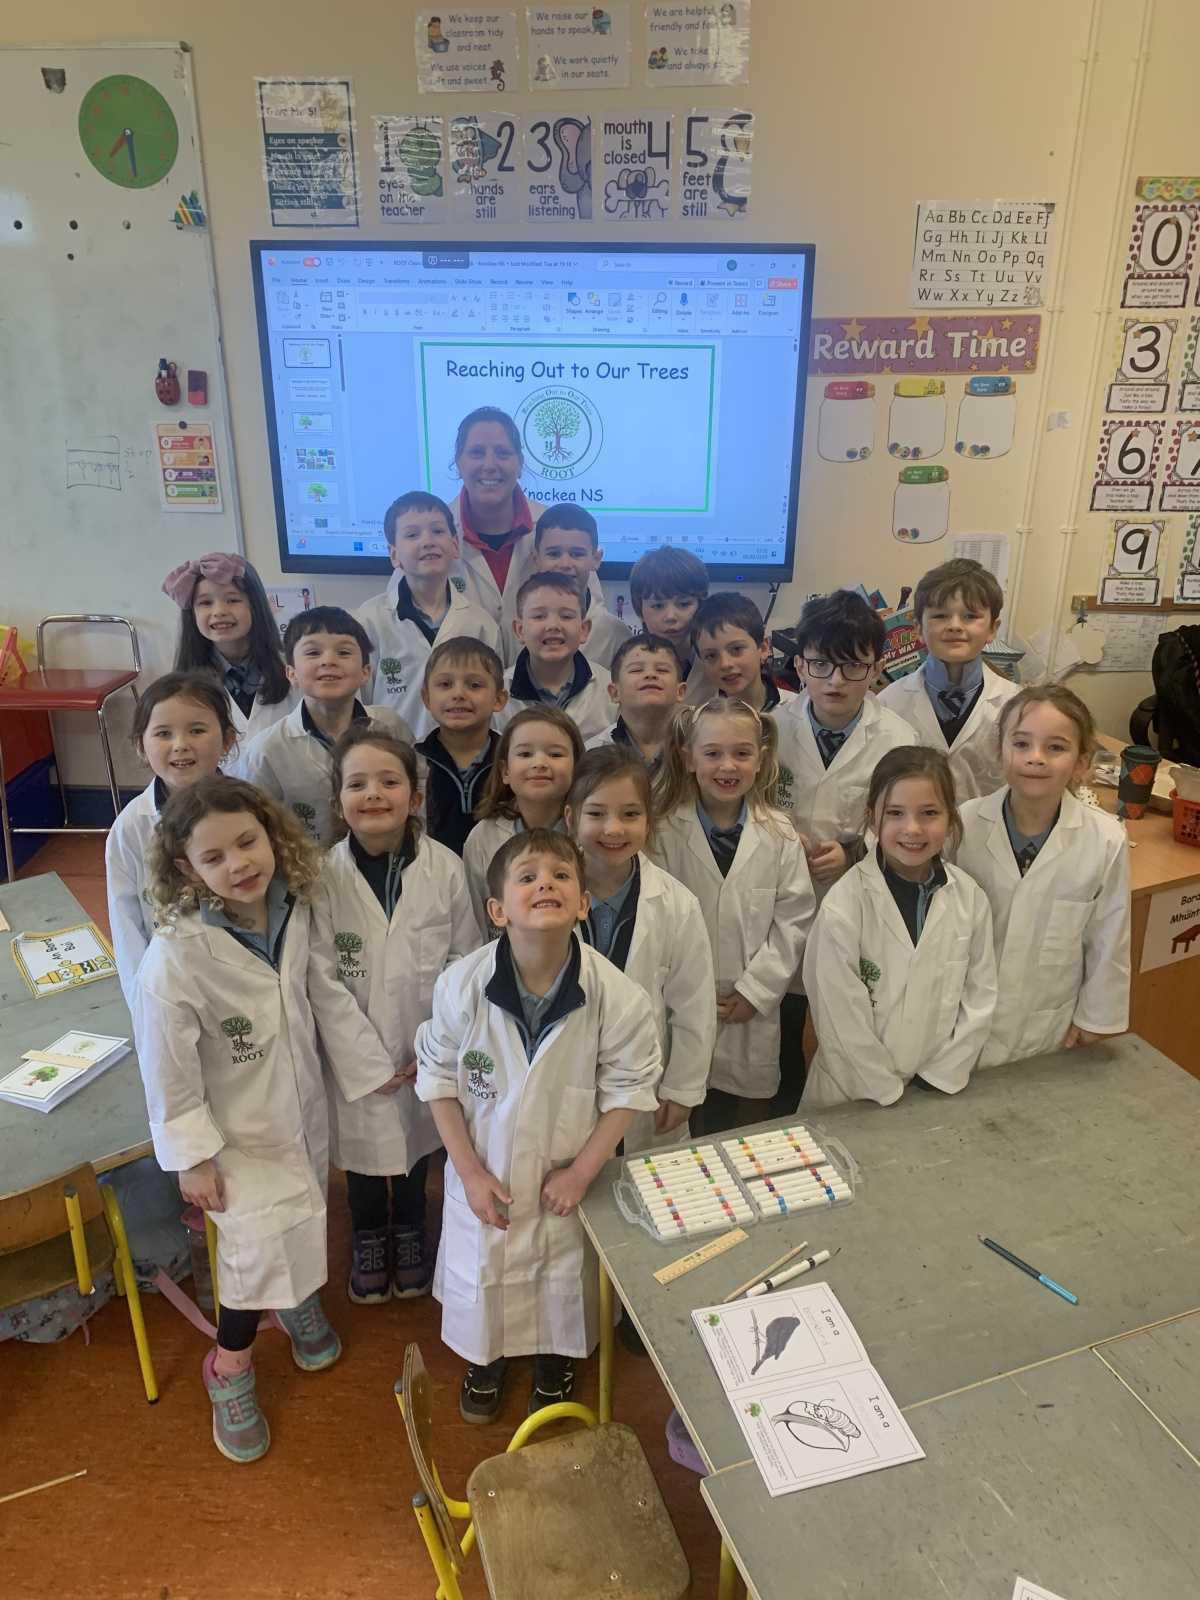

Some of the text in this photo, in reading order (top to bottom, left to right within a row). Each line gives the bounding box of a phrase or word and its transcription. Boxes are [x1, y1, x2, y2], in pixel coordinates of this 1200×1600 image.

[653, 8, 667, 16] We
[650, 22, 682, 32] friendly
[684, 22, 699, 30] and
[674, 48, 689, 56] We
[604, 120, 647, 135] mouth
[496, 120, 515, 172] 2
[527, 121, 552, 173] 3
[621, 136, 632, 151] is
[647, 121, 670, 170] 4
[686, 116, 709, 168] 5
[603, 149, 646, 165] closed
[683, 171, 711, 186] feet
[471, 183, 504, 196] hands
[529, 184, 556, 195] ears
[683, 188, 708, 201] are
[379, 193, 393, 204] on
[475, 195, 496, 205] are
[539, 195, 560, 205] are
[381, 205, 425, 217] teacher
[475, 206, 496, 219] still
[528, 205, 576, 219] listening
[682, 202, 707, 217] still
[925, 210, 944, 224] Aa
[949, 210, 966, 224] Bb
[971, 210, 987, 224] Cc
[992, 211, 1012, 224] Dd
[1016, 211, 1032, 224] Ee
[923, 230, 1048, 248] Gg Hh Ii Jj Kk Ll
[1151, 215, 1182, 267] 0
[921, 249, 1044, 268] Mm Nn Oo Pp Qq
[919, 269, 1042, 283] Rr Ss Tt Uu Vv
[918, 288, 1018, 305] Ww Xx Yy Zz
[813, 329, 1027, 360] Reward Time
[1130, 325, 1161, 373] 3
[447, 360, 689, 383] Reaching Out to Our Trees
[1118, 429, 1146, 475] 6
[541, 467, 575, 479] ROOT
[581, 488, 604, 502] NS
[1121, 528, 1150, 570] 9
[884, 641, 916, 660] MY WAY
[232, 1049, 264, 1064] ROOT
[467, 1085, 498, 1099] ROOT
[825, 1316, 836, 1328] am
[874, 1404, 885, 1420] am
